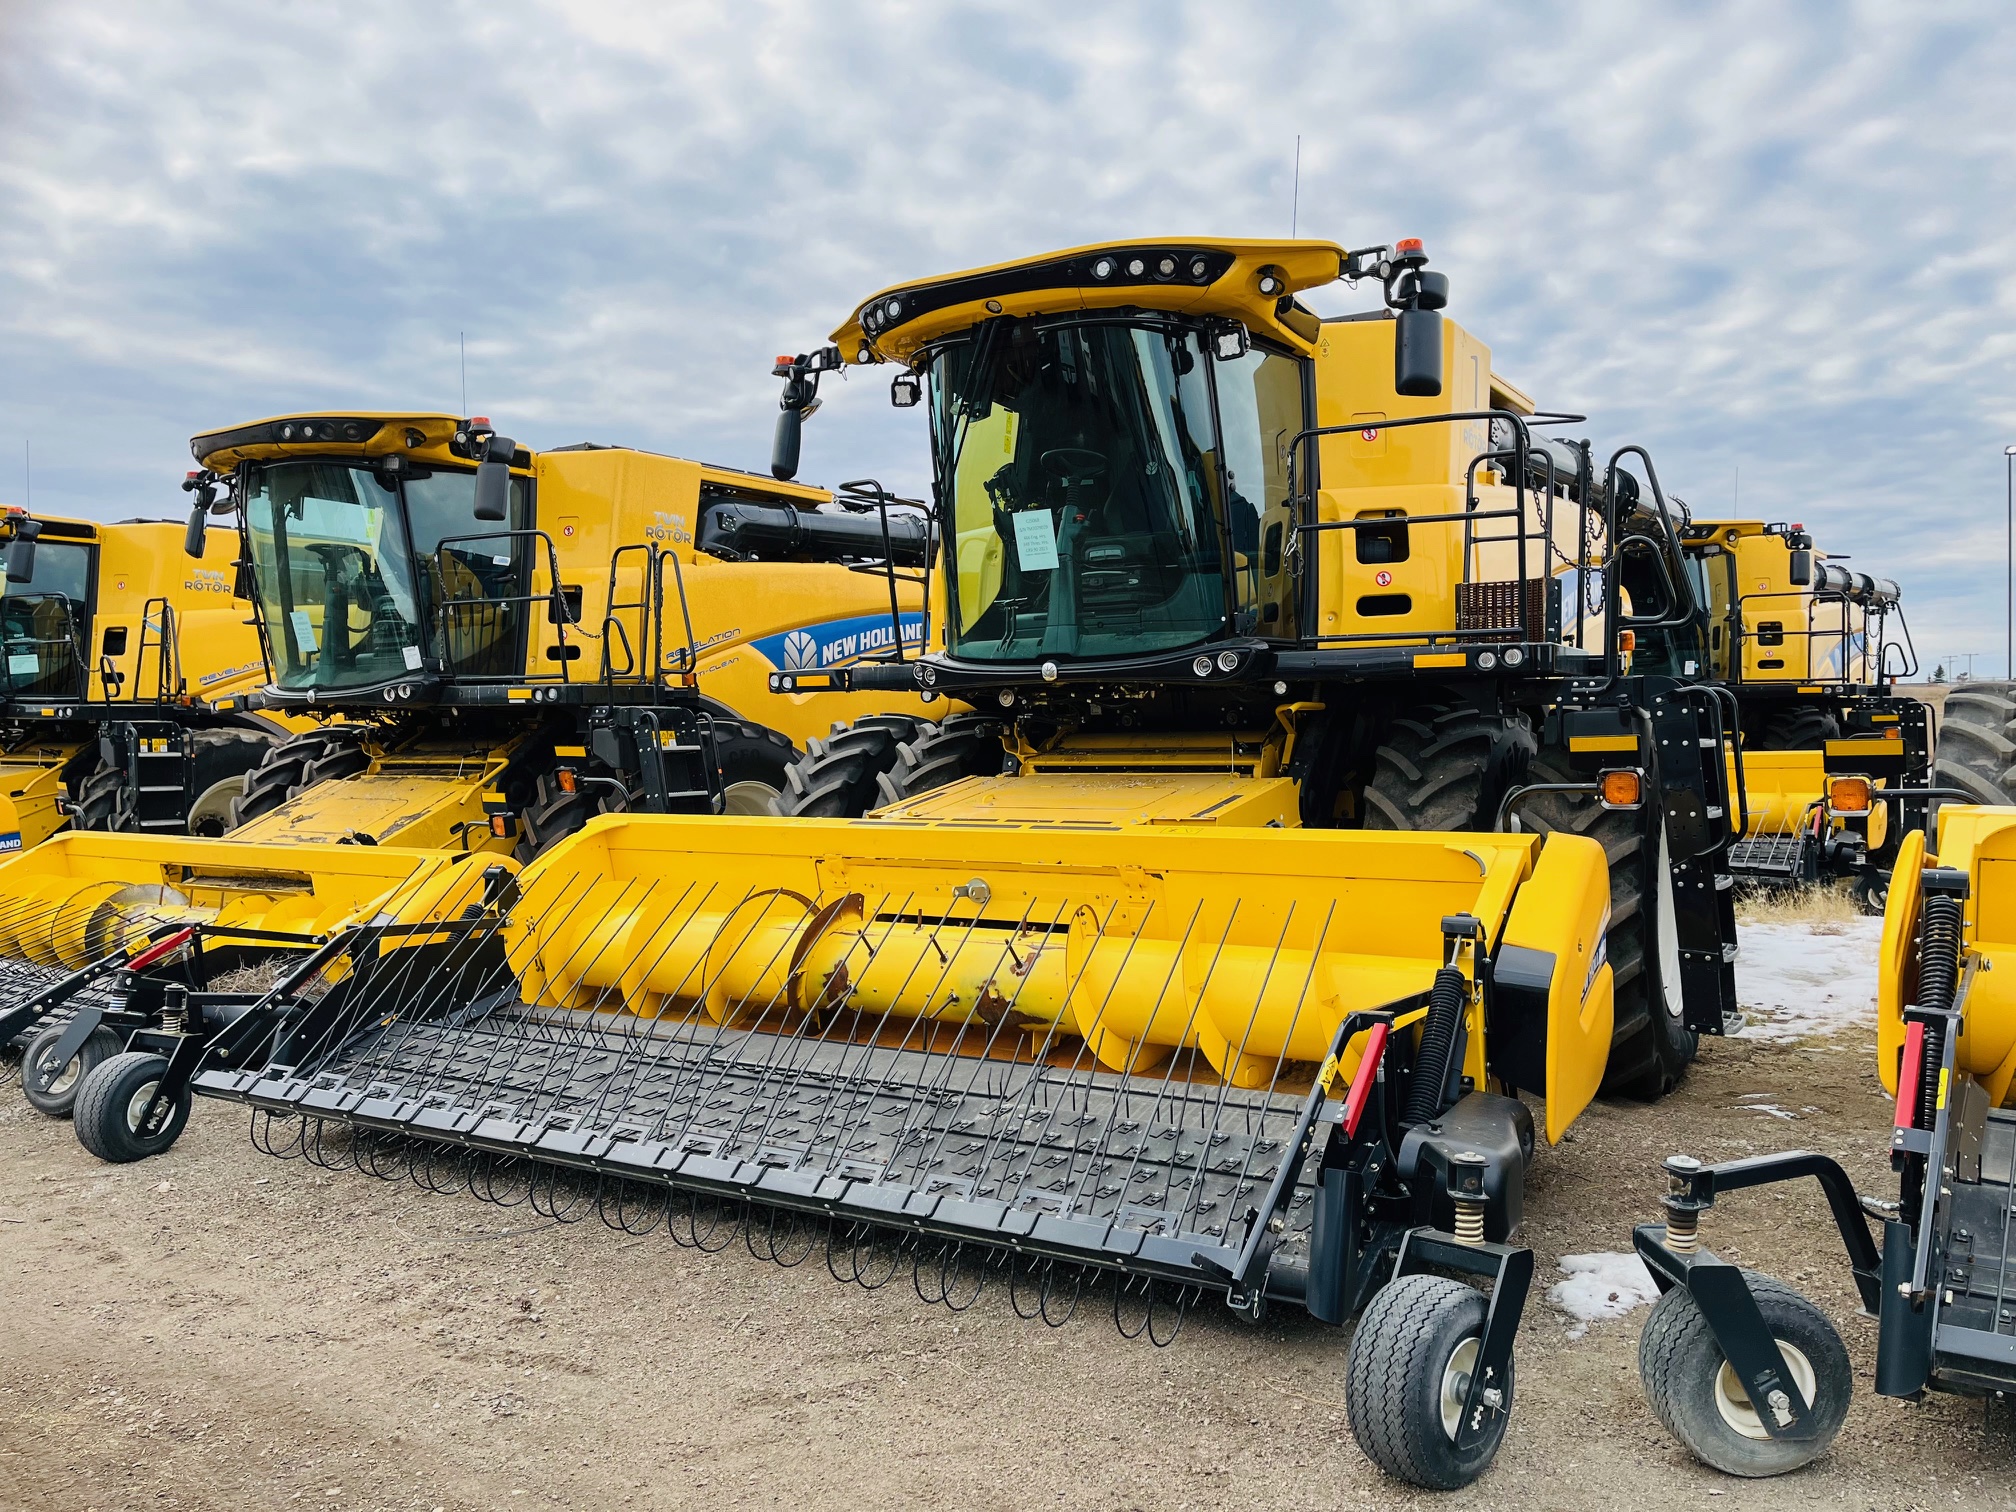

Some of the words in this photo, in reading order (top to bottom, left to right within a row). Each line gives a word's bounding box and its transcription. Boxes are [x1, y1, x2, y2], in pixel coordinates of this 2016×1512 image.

[654, 511, 685, 527] TWIN
[646, 524, 691, 544] ROTOR
[193, 569, 225, 581] TWIN
[185, 580, 231, 593] ROTOR
[822, 634, 857, 666] NEW
